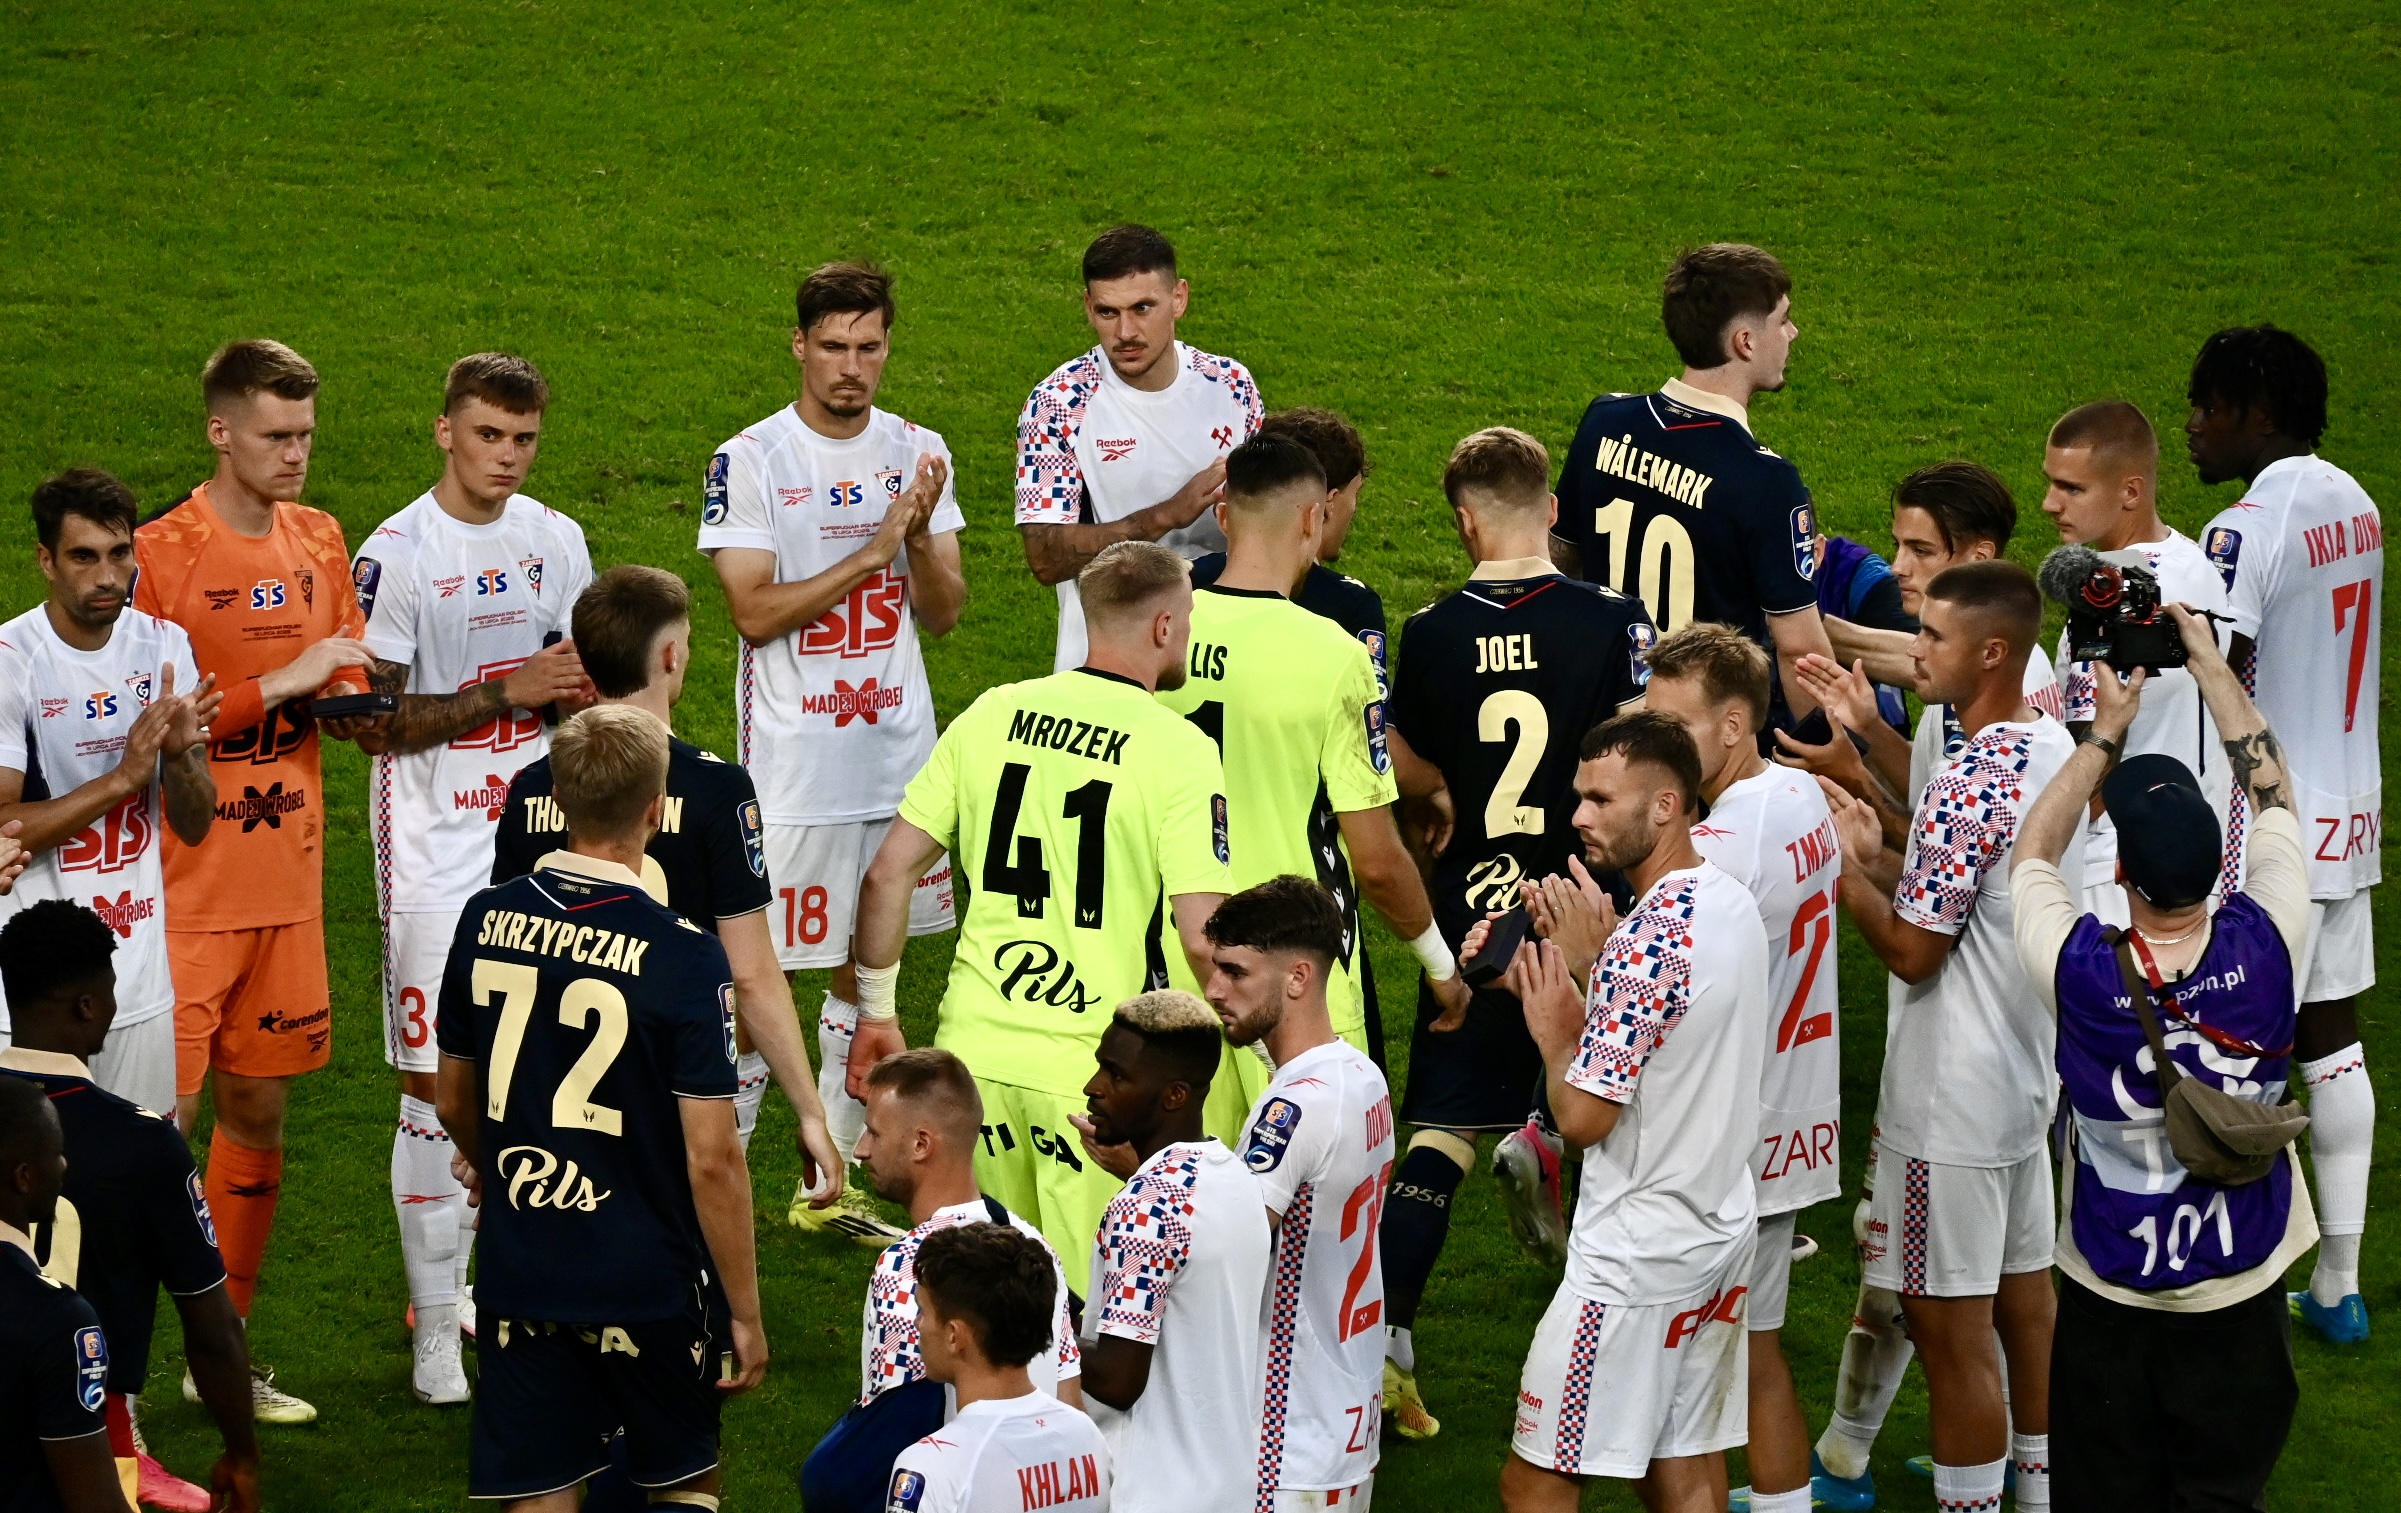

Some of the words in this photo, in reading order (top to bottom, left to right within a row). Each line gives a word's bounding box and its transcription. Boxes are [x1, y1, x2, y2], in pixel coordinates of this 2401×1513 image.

[1097, 437, 1136, 447] Reebok
[778, 486, 812, 496] Reebok
[829, 480, 864, 508] STS
[1596, 434, 1714, 509] WÅLEMARK
[2303, 521, 2347, 568] IKIA
[2352, 511, 2382, 555] DIM
[204, 588, 240, 598] Reebok
[433, 575, 465, 587] Reebok
[477, 569, 507, 596] STS
[1595, 497, 1695, 637] 10
[251, 579, 285, 610] STS
[1190, 642, 1228, 681] LIS
[1475, 634, 1538, 674] JOEL
[2332, 578, 2371, 733] 7
[86, 691, 118, 720] STS
[802, 692, 856, 714] MADEJ
[1007, 710, 1131, 765] MROZEK
[1477, 690, 1549, 839] 2
[213, 797, 261, 821] MADEJ
[264, 789, 306, 816] WRÓBEL
[454, 785, 507, 810] MADEJ
[983, 762, 1113, 930] 41
[2315, 809, 2381, 861] ZARY
[915, 866, 953, 888] orendo
[937, 889, 953, 901] Reeb
[1465, 853, 1540, 911] Pil
[115, 898, 154, 928] WRÓBE
[779, 885, 828, 948] 18
[477, 908, 650, 977] SKRZYPCZAK
[1776, 874, 1841, 1054] 2
[994, 940, 1101, 1014] Pils
[280, 1007, 329, 1031] corendon
[400, 986, 438, 1048] 3
[471, 958, 629, 1138] 72
[498, 1145, 611, 1212] Pils
[1391, 1181, 1446, 1208] 1956
[2129, 1191, 2233, 1276] 101
[1345, 1390, 1382, 1453] ZAR
[1017, 1454, 1100, 1512] KHLAN
